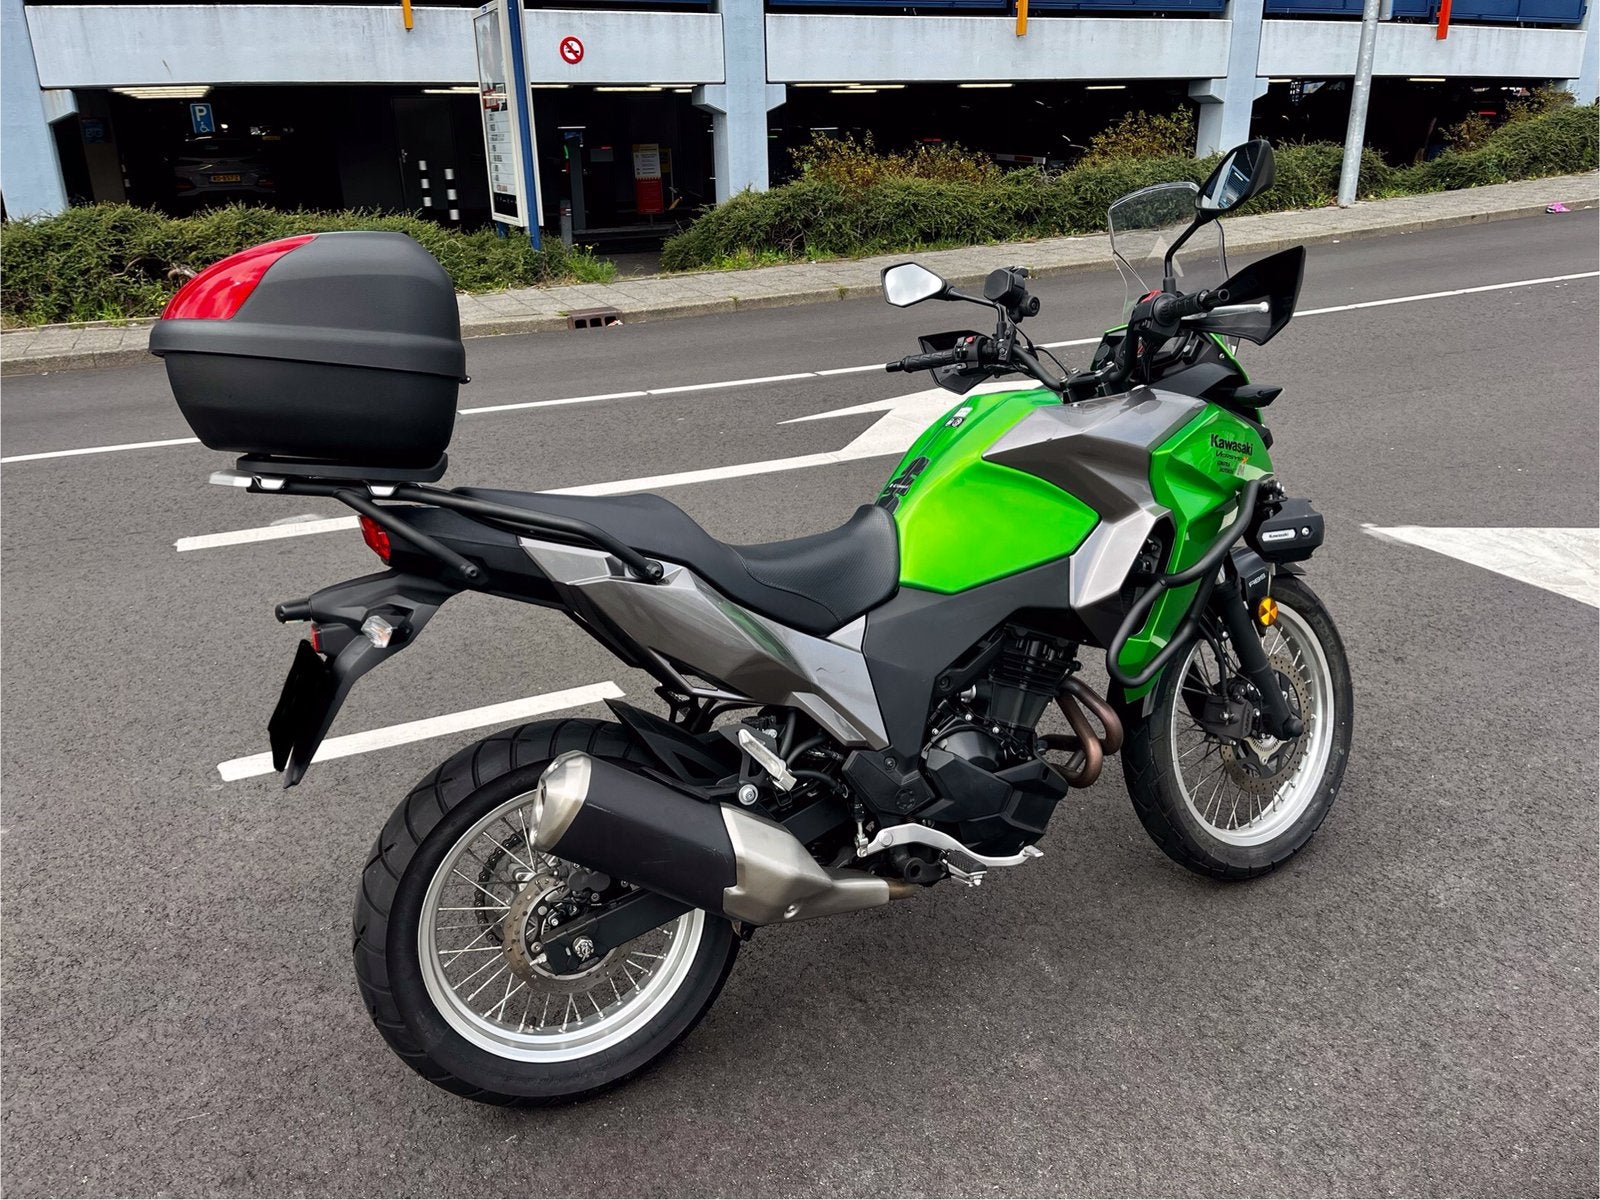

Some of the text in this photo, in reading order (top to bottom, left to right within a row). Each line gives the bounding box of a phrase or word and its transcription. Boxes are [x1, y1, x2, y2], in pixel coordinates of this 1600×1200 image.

[194, 105, 207, 121] P
[1210, 433, 1253, 456] Kawasaki
[1248, 572, 1266, 588] ABS
